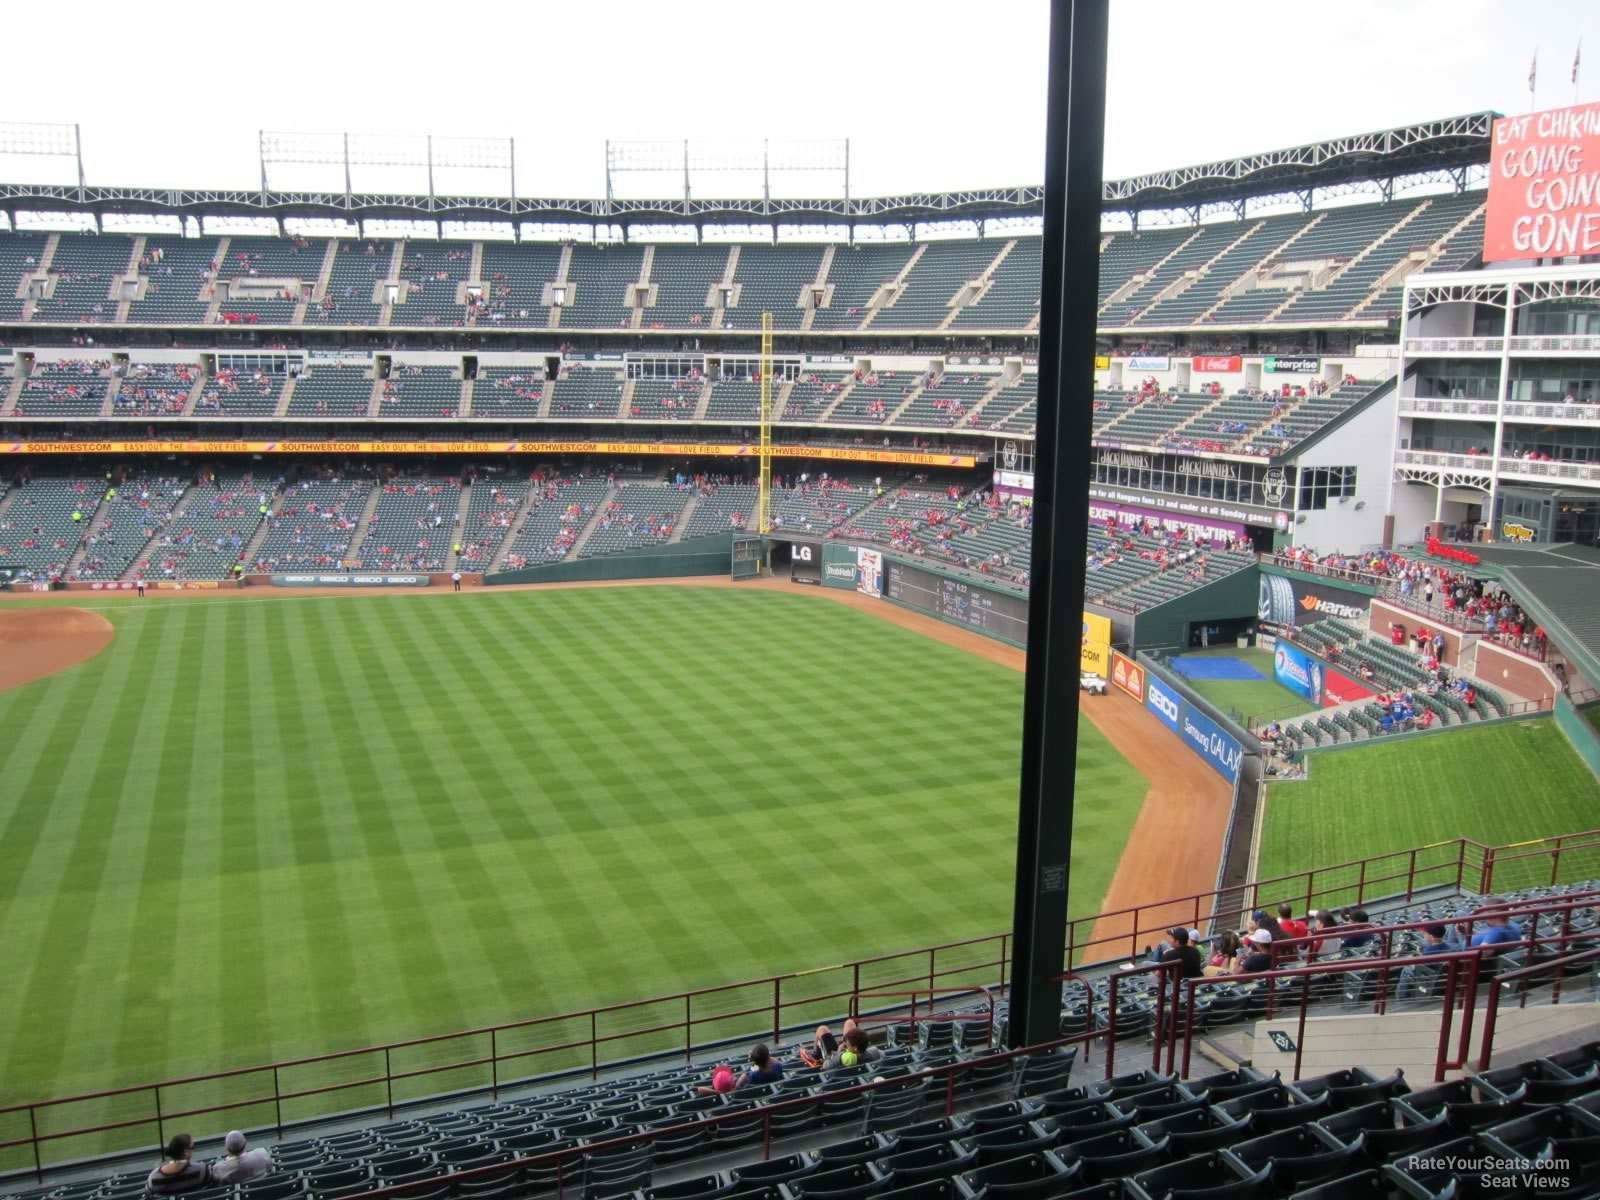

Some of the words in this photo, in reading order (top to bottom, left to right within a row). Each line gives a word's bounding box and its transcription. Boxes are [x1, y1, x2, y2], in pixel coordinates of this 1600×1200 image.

[1496, 116, 1533, 146] EAT
[1538, 107, 1600, 140] CHIKIN
[1502, 145, 1583, 179] GOING
[1512, 211, 1600, 254] GONE
[1264, 360, 1318, 371] enterprise
[27, 443, 112, 451] SOUTHWEST.COM
[124, 443, 144, 451] EASY
[170, 443, 184, 451] THE
[204, 443, 223, 451] LOVE
[281, 443, 360, 451] SOUTHWEST.COM
[371, 443, 390, 451] EASY
[413, 443, 428, 451] THE
[447, 443, 465, 451] LOVE
[522, 443, 597, 451] SOUTHWEST.COM
[608, 444, 625, 452] EASY
[648, 445, 660, 453] THE
[752, 447, 822, 456] SOUTHWEST.COM
[831, 450, 846, 458] EASY
[895, 453, 912, 462] LOVE
[1100, 450, 1119, 466] JACK
[1179, 459, 1200, 475] JACK
[1098, 489, 1107, 497] for
[1108, 490, 1116, 498] all
[1117, 491, 1140, 503] Rangers
[1142, 496, 1155, 505] fans
[1157, 498, 1165, 507] 13
[1166, 499, 1178, 509] and
[1180, 502, 1199, 512] under
[1200, 504, 1209, 513] at
[1210, 506, 1219, 515] all
[1221, 507, 1247, 521] Sunday
[1248, 513, 1273, 523] games
[1089, 506, 1117, 520] EXEN
[1118, 511, 1143, 526] TIRE
[792, 545, 812, 561] LG
[1149, 684, 1178, 722] GEICO
[1184, 717, 1209, 752] Samsung
[1275, 1033, 1289, 1050] 251
